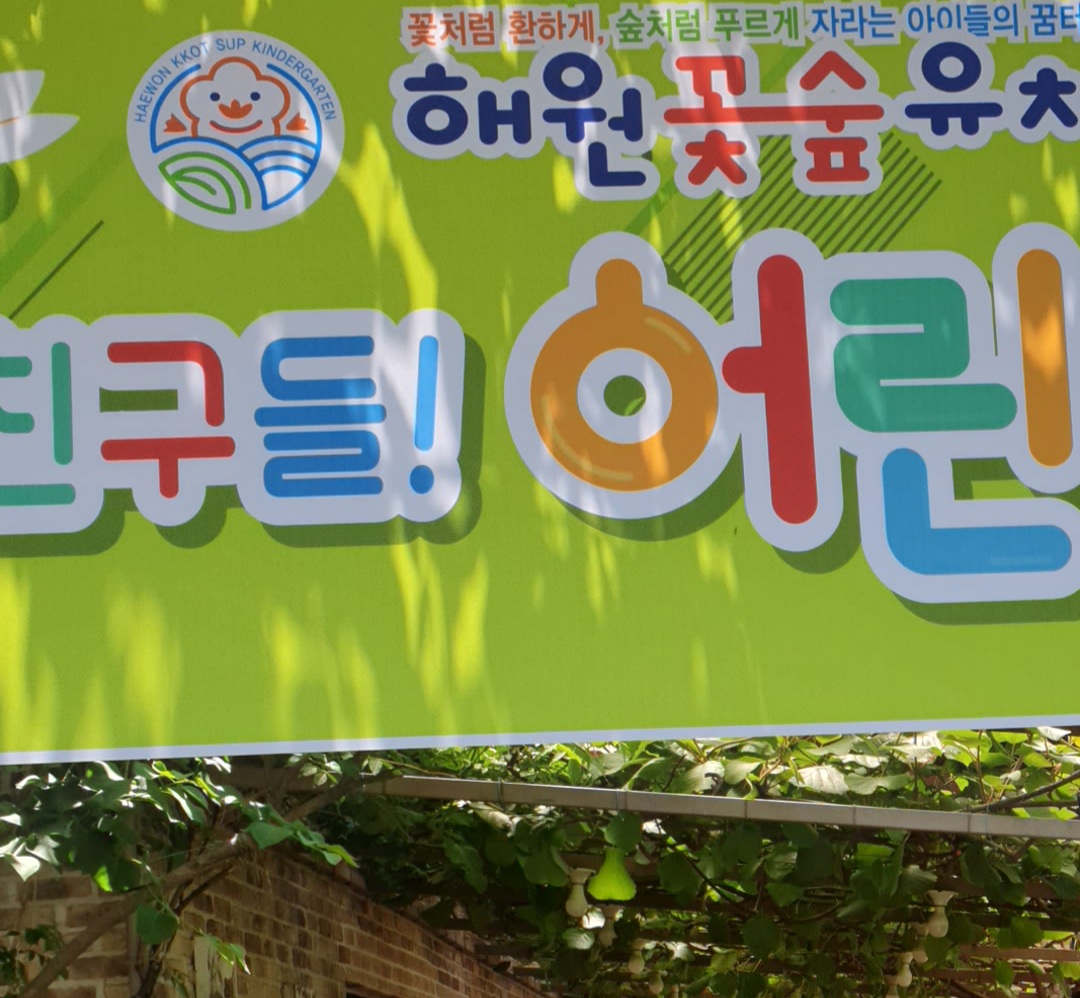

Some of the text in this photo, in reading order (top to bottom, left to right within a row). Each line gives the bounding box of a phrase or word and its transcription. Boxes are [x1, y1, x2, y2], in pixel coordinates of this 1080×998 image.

[402, 10, 496, 47] 꽃처럼
[508, 9, 605, 47] 환하게,
[615, 8, 701, 44] 숲처럼
[714, 7, 799, 41] 푸르게
[811, 6, 896, 39] 자라는
[907, 4, 1019, 38] 아이들의
[134, 37, 337, 123] HAEWON KKOT SUP KINDERGARTEN
